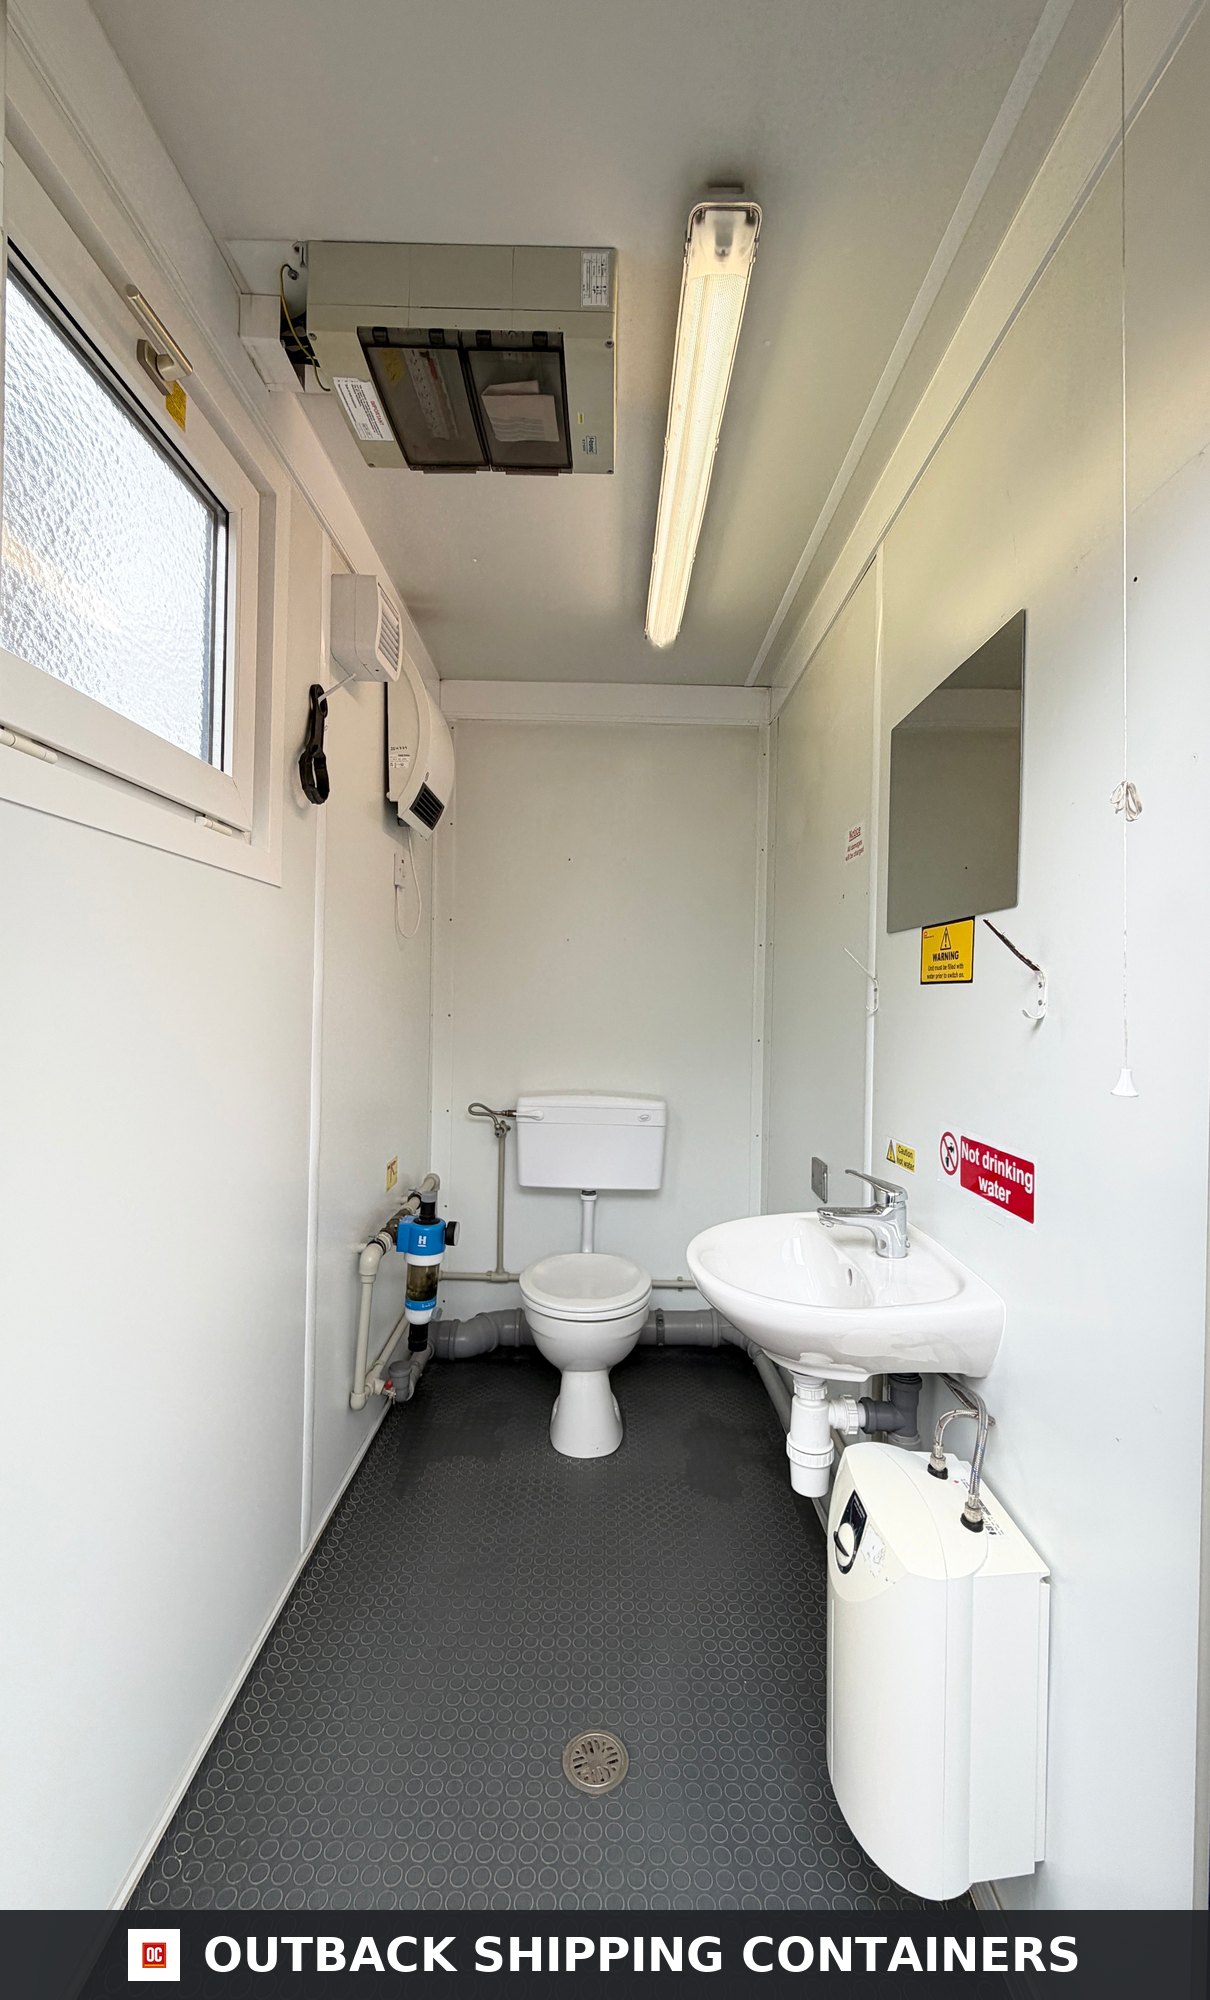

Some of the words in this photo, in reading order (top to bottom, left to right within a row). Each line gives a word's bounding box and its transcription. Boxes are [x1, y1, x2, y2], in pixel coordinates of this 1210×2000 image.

[932, 951, 959, 962] WARNING
[898, 1145, 913, 1159] Caution
[904, 1161, 915, 1171] water
[962, 1141, 980, 1166] Not
[982, 1151, 1034, 1194] drinking
[978, 1176, 1012, 1204] water
